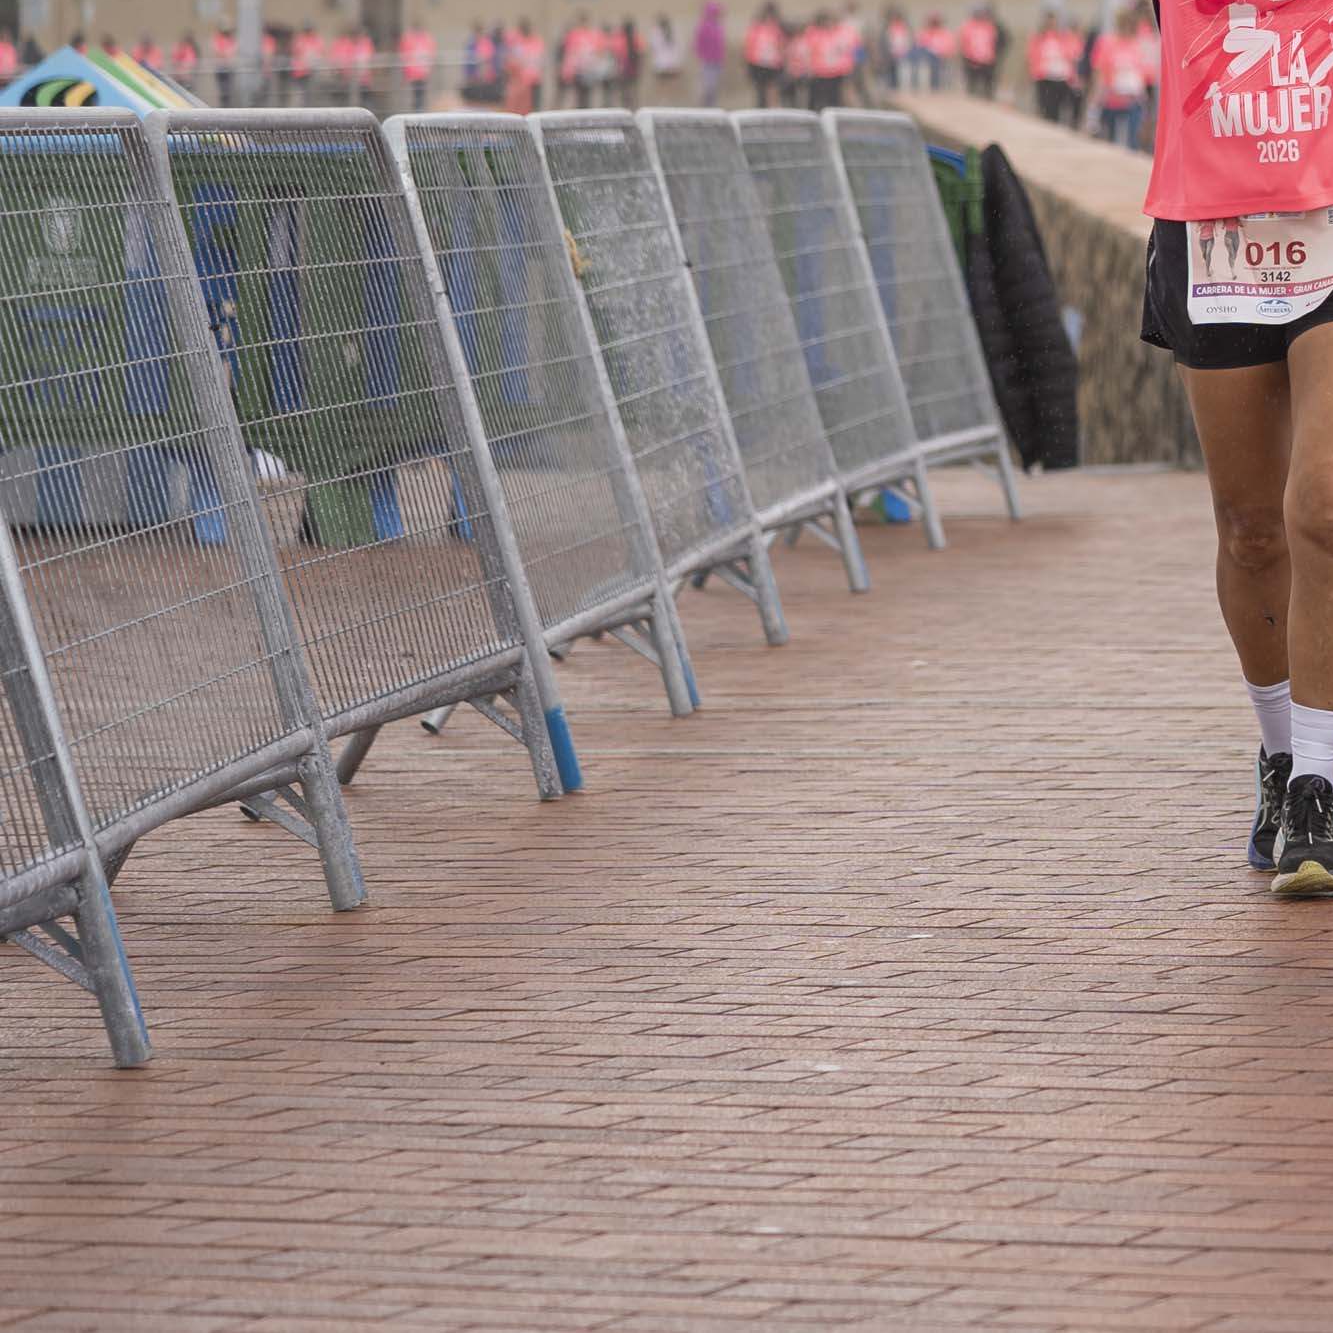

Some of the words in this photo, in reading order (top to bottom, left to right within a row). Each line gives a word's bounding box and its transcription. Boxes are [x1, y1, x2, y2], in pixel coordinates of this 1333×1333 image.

[1269, 30, 1310, 87] LA
[1210, 84, 1333, 138] MUJER
[1256, 139, 1300, 163] 2026
[1245, 241, 1307, 267] 016
[1260, 271, 1291, 283] 3142
[1196, 286, 1232, 296] CARRERA
[1234, 286, 1245, 294] DE
[1247, 286, 1257, 295] LA
[1258, 286, 1287, 296] MUJER
[1293, 283, 1313, 294] GRAN
[1206, 305, 1238, 314] OYSHO
